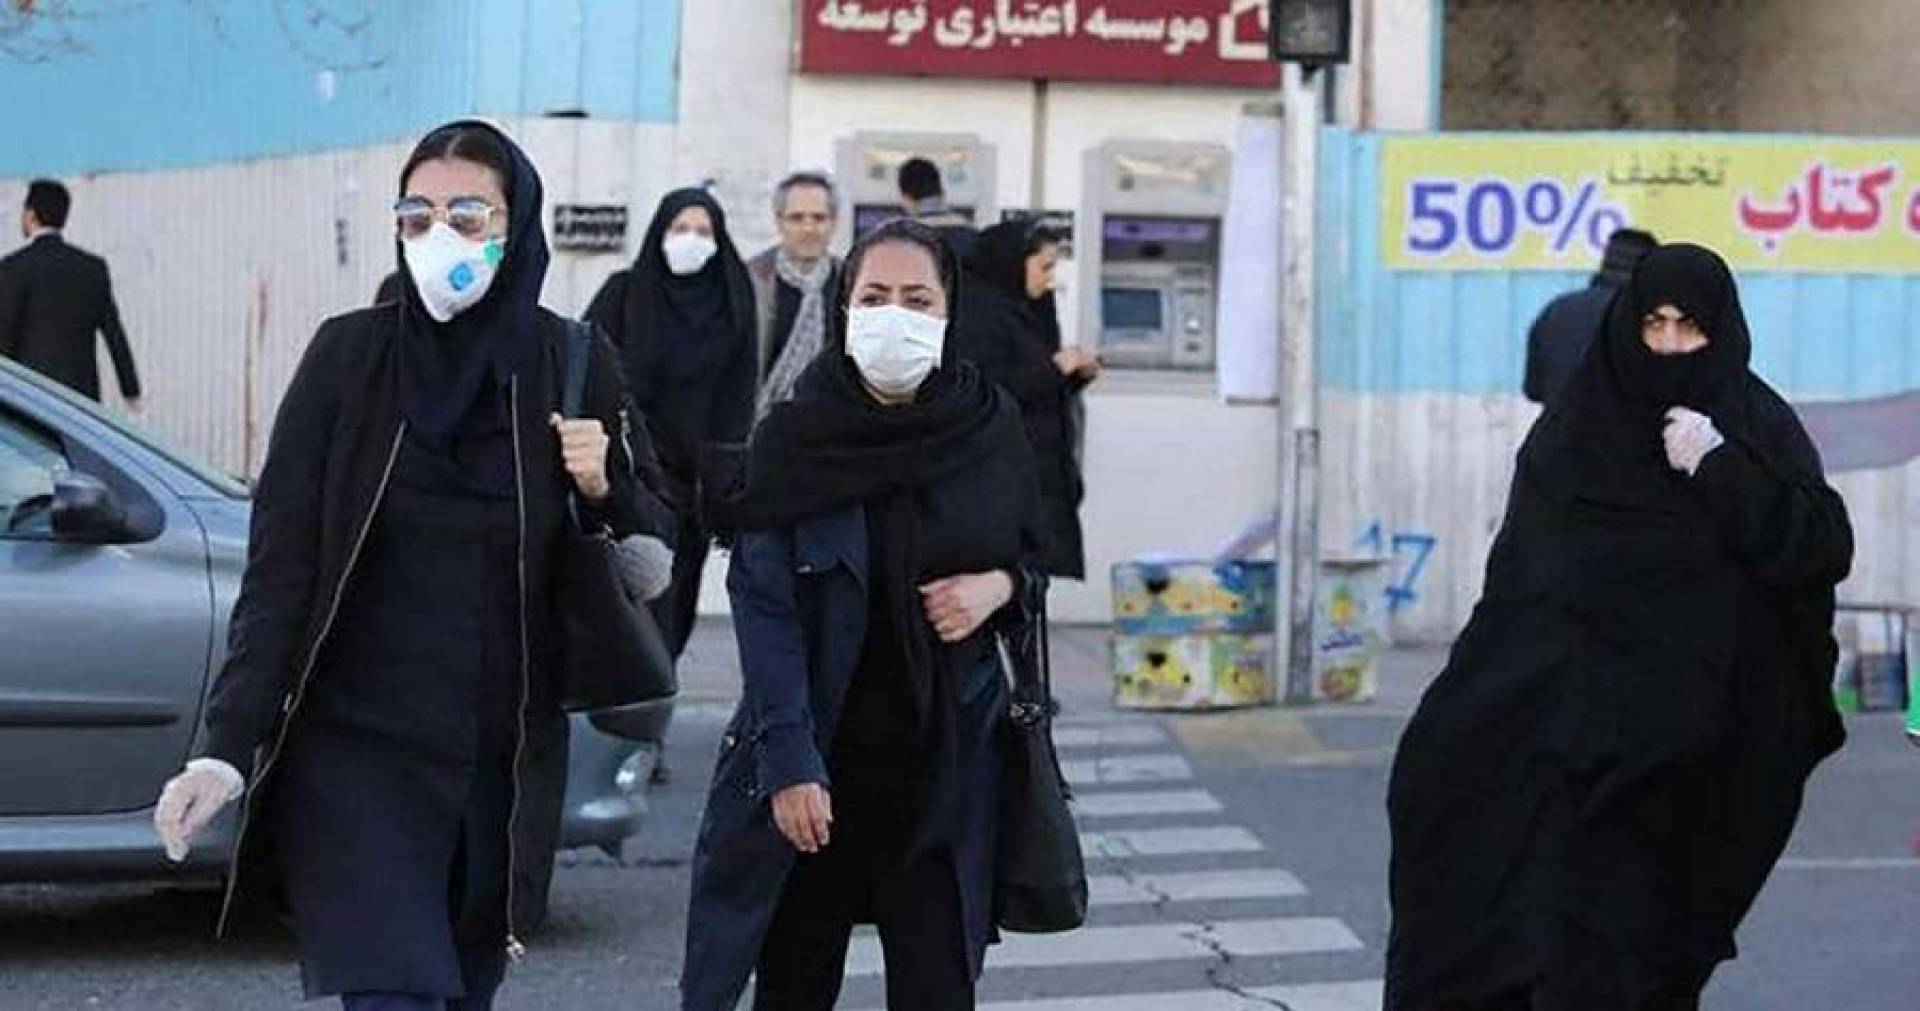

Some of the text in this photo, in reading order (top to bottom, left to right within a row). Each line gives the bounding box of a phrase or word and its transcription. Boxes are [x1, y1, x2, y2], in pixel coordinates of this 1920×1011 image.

[934, 0, 1076, 49] اعتباری
[1084, 6, 1209, 55] موسسه
[1608, 152, 1731, 198] تخفیف
[1408, 180, 1626, 252] 50%
[1740, 164, 1896, 250] کتاب
